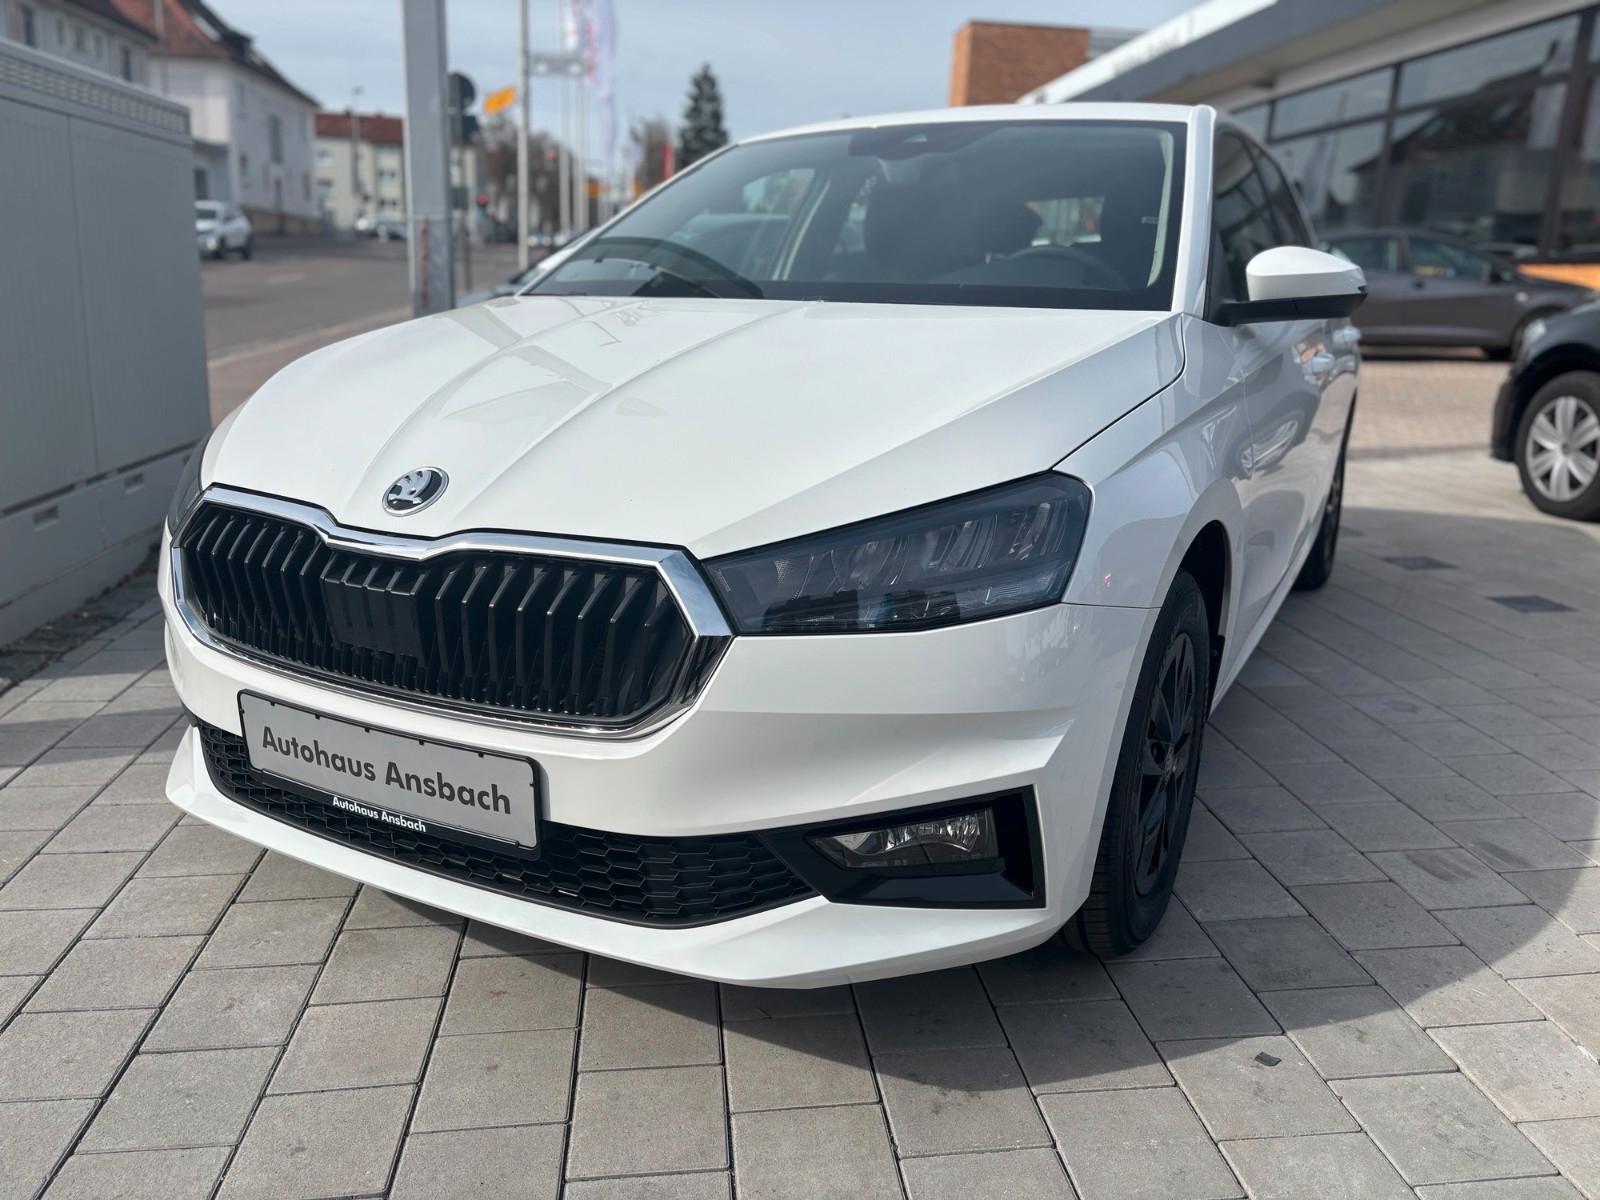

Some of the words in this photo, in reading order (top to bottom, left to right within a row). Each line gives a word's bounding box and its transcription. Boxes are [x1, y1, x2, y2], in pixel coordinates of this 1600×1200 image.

[262, 726, 376, 781] Autohaus
[385, 761, 511, 814] Ansbach
[332, 796, 379, 819] Autohaus
[381, 811, 426, 832] Ansbach
